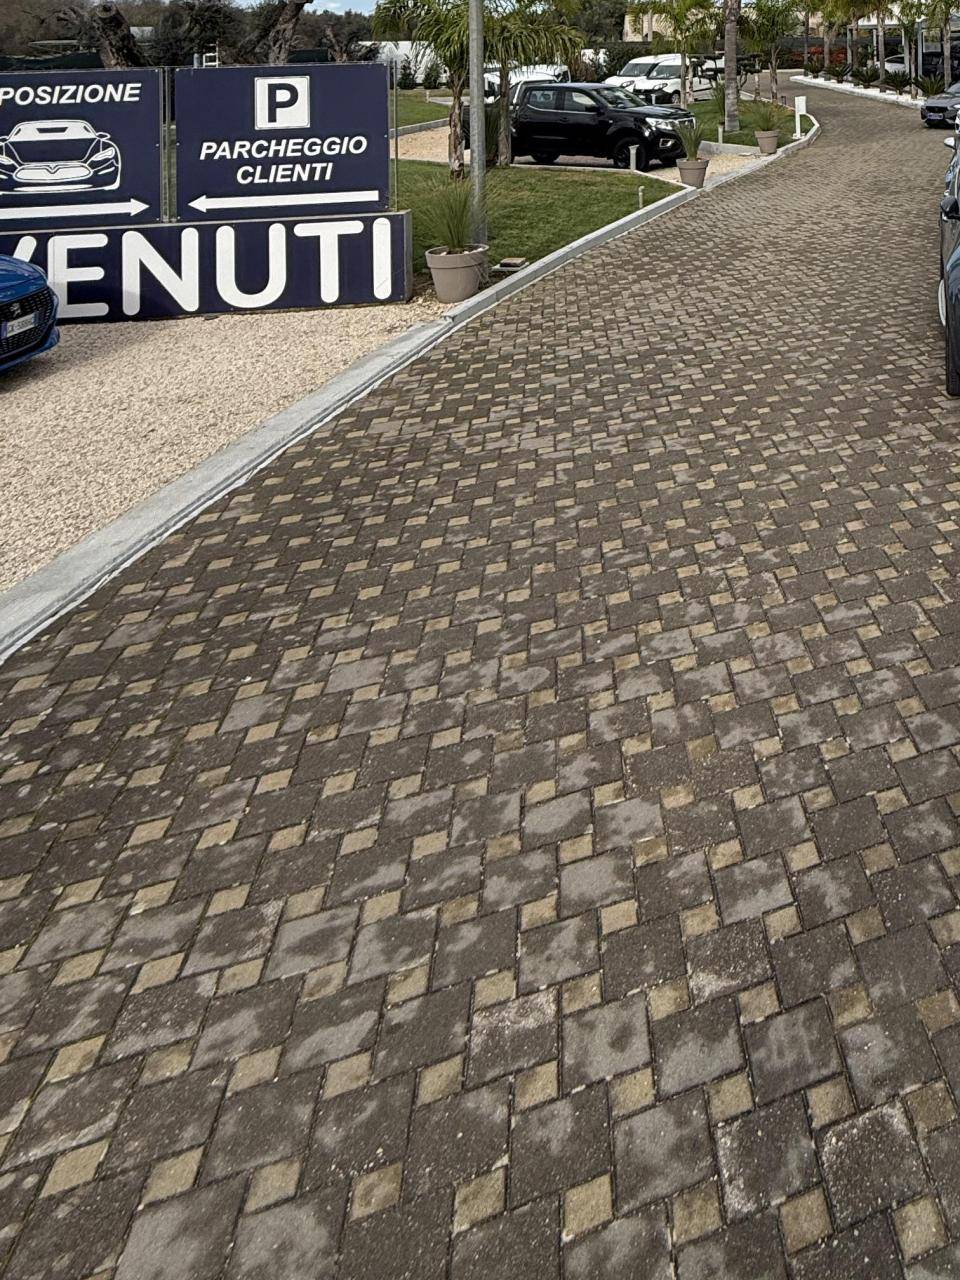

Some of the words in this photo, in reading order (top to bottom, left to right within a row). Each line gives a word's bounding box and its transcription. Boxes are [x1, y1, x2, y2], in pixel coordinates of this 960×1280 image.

[0, 83, 142, 105] POSIZIONE
[267, 82, 299, 123] P
[199, 136, 367, 160] PARCHEGGIO
[236, 162, 333, 184] CLIENTI
